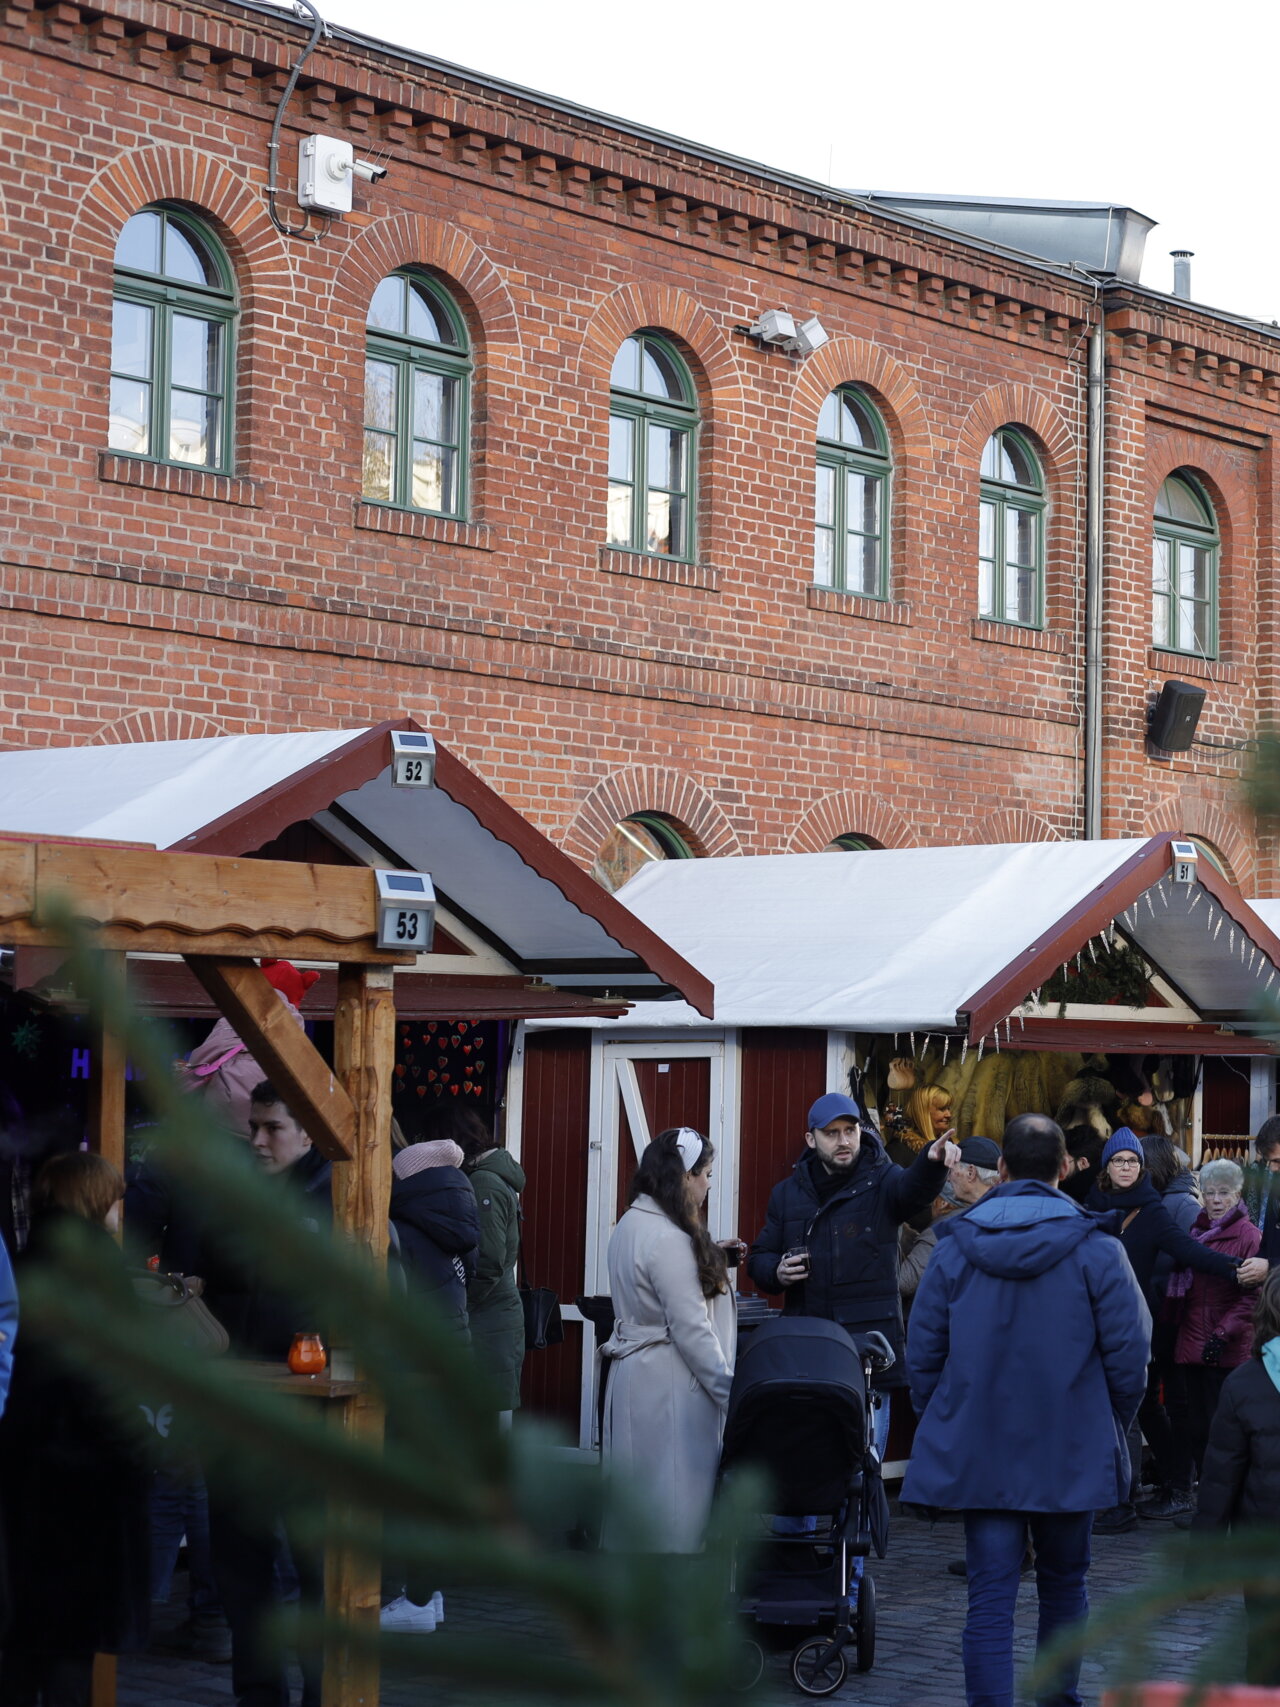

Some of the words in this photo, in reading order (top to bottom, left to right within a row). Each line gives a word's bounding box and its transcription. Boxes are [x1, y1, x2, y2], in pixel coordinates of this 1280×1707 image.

[405, 761, 423, 781] 52
[1180, 864, 1189, 880] 51
[396, 912, 418, 940] 53
